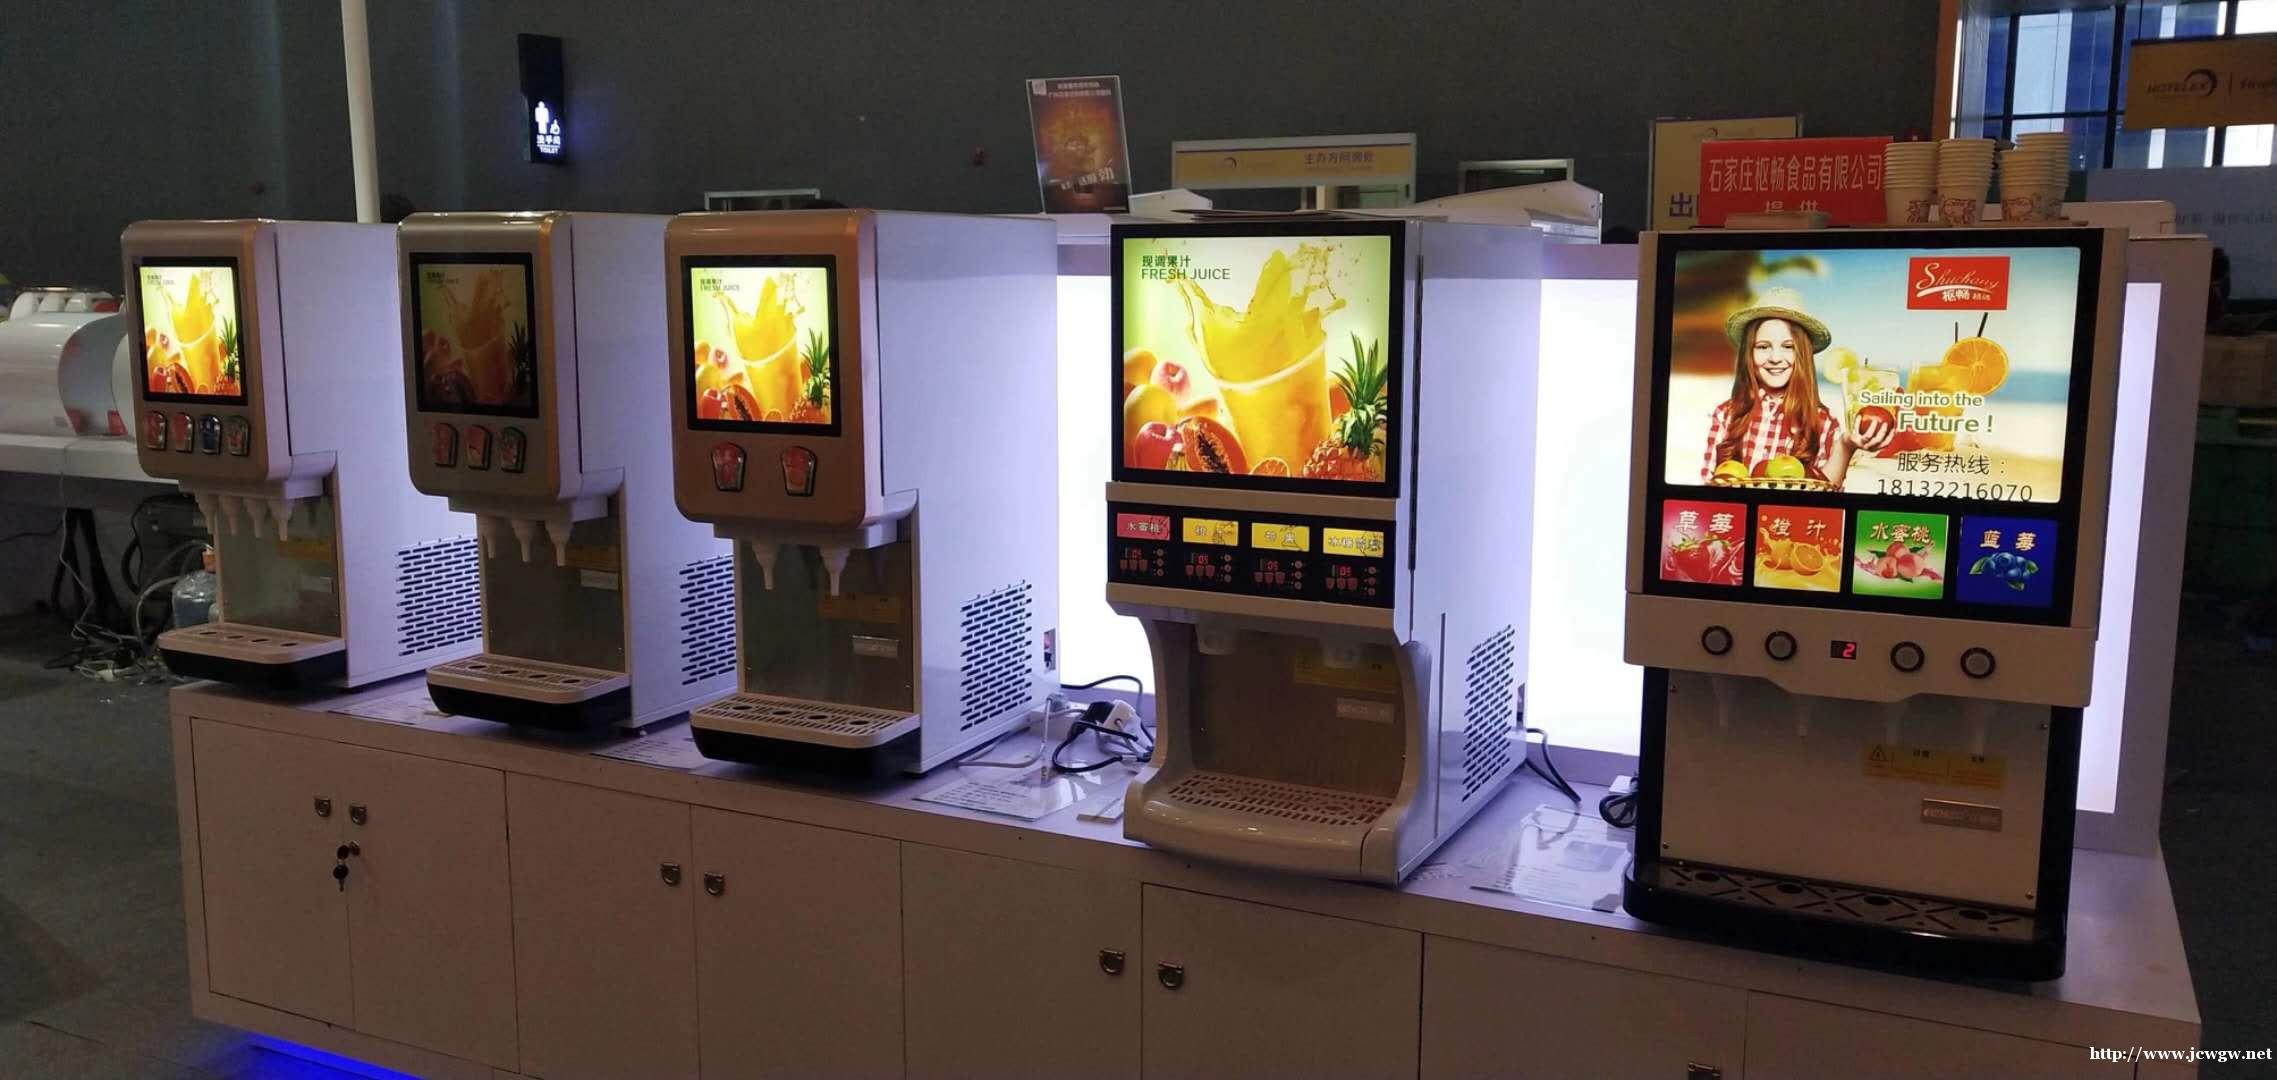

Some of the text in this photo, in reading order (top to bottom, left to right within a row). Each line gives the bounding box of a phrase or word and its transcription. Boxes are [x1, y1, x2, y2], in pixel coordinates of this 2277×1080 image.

[1708, 154, 1883, 193] 石家庄枢畅食品有限公司
[1142, 255, 1191, 267] 现调果汁
[1142, 268, 1231, 280] FRESH JUICE
[1860, 391, 1983, 407] Sailing into the
[1899, 412, 1980, 432] Future
[1878, 479, 2034, 501] 18132216070
[1675, 510, 1735, 533] 草莓
[1772, 517, 1826, 537] 橙汁
[1870, 522, 1933, 542] 水蜜桃
[1980, 530, 2037, 550] 蓝莓
